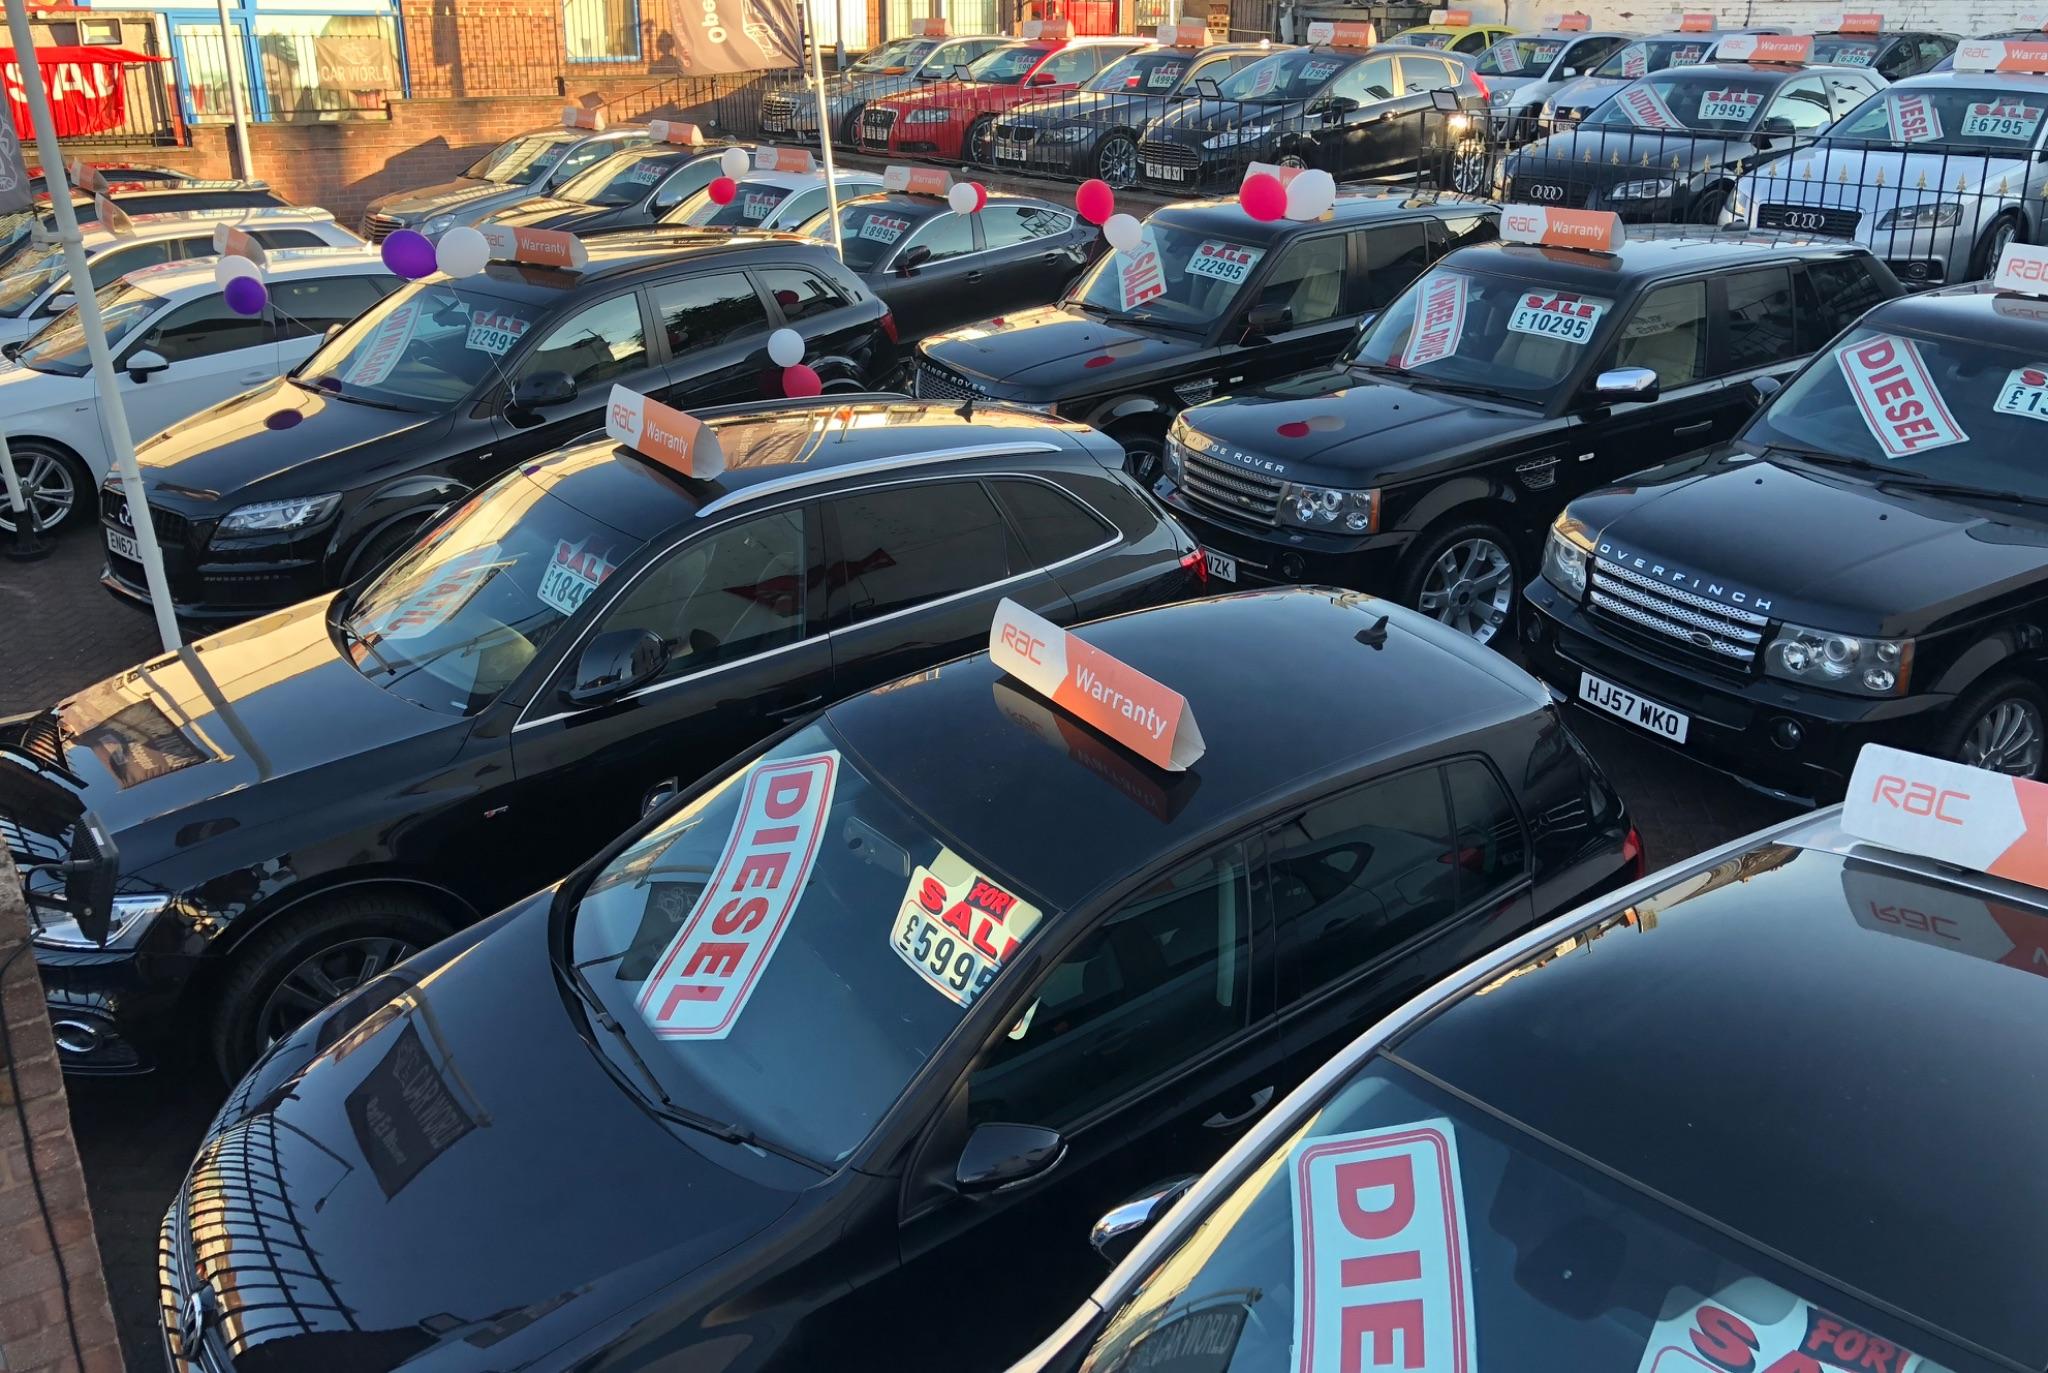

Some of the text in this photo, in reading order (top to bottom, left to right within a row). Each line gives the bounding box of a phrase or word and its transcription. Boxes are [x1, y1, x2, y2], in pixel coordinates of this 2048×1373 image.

[1761, 41, 1804, 52] Warranty
[6, 62, 119, 103] SAL
[321, 64, 390, 81] CAR WORLD
[1707, 91, 1760, 105] SALE
[1974, 104, 2040, 120] SALE
[1970, 117, 2024, 136] £6795
[871, 216, 908, 231] SALE
[1552, 220, 1605, 240] Warranty
[521, 238, 567, 256] Warranty
[1201, 245, 1252, 265] SALE
[1122, 251, 1163, 308] SALE
[1193, 257, 1245, 280] £22995
[1424, 286, 1456, 331] WHEEL
[1525, 295, 1593, 319] SALE
[475, 311, 525, 333] SALE
[1517, 312, 1589, 339] £10295
[1413, 327, 1450, 362] DRIVE
[921, 362, 986, 391] RANGE ROVER
[1858, 340, 1940, 449] DIESEL
[647, 419, 689, 459] Warranty
[1233, 452, 1285, 473] ROVER
[1600, 544, 1772, 611] OVERFINCH
[1075, 664, 1168, 740] Warranty
[1587, 677, 1636, 718] HJ57
[656, 770, 813, 1021] DIESEL
[968, 880, 1011, 919] FOR
